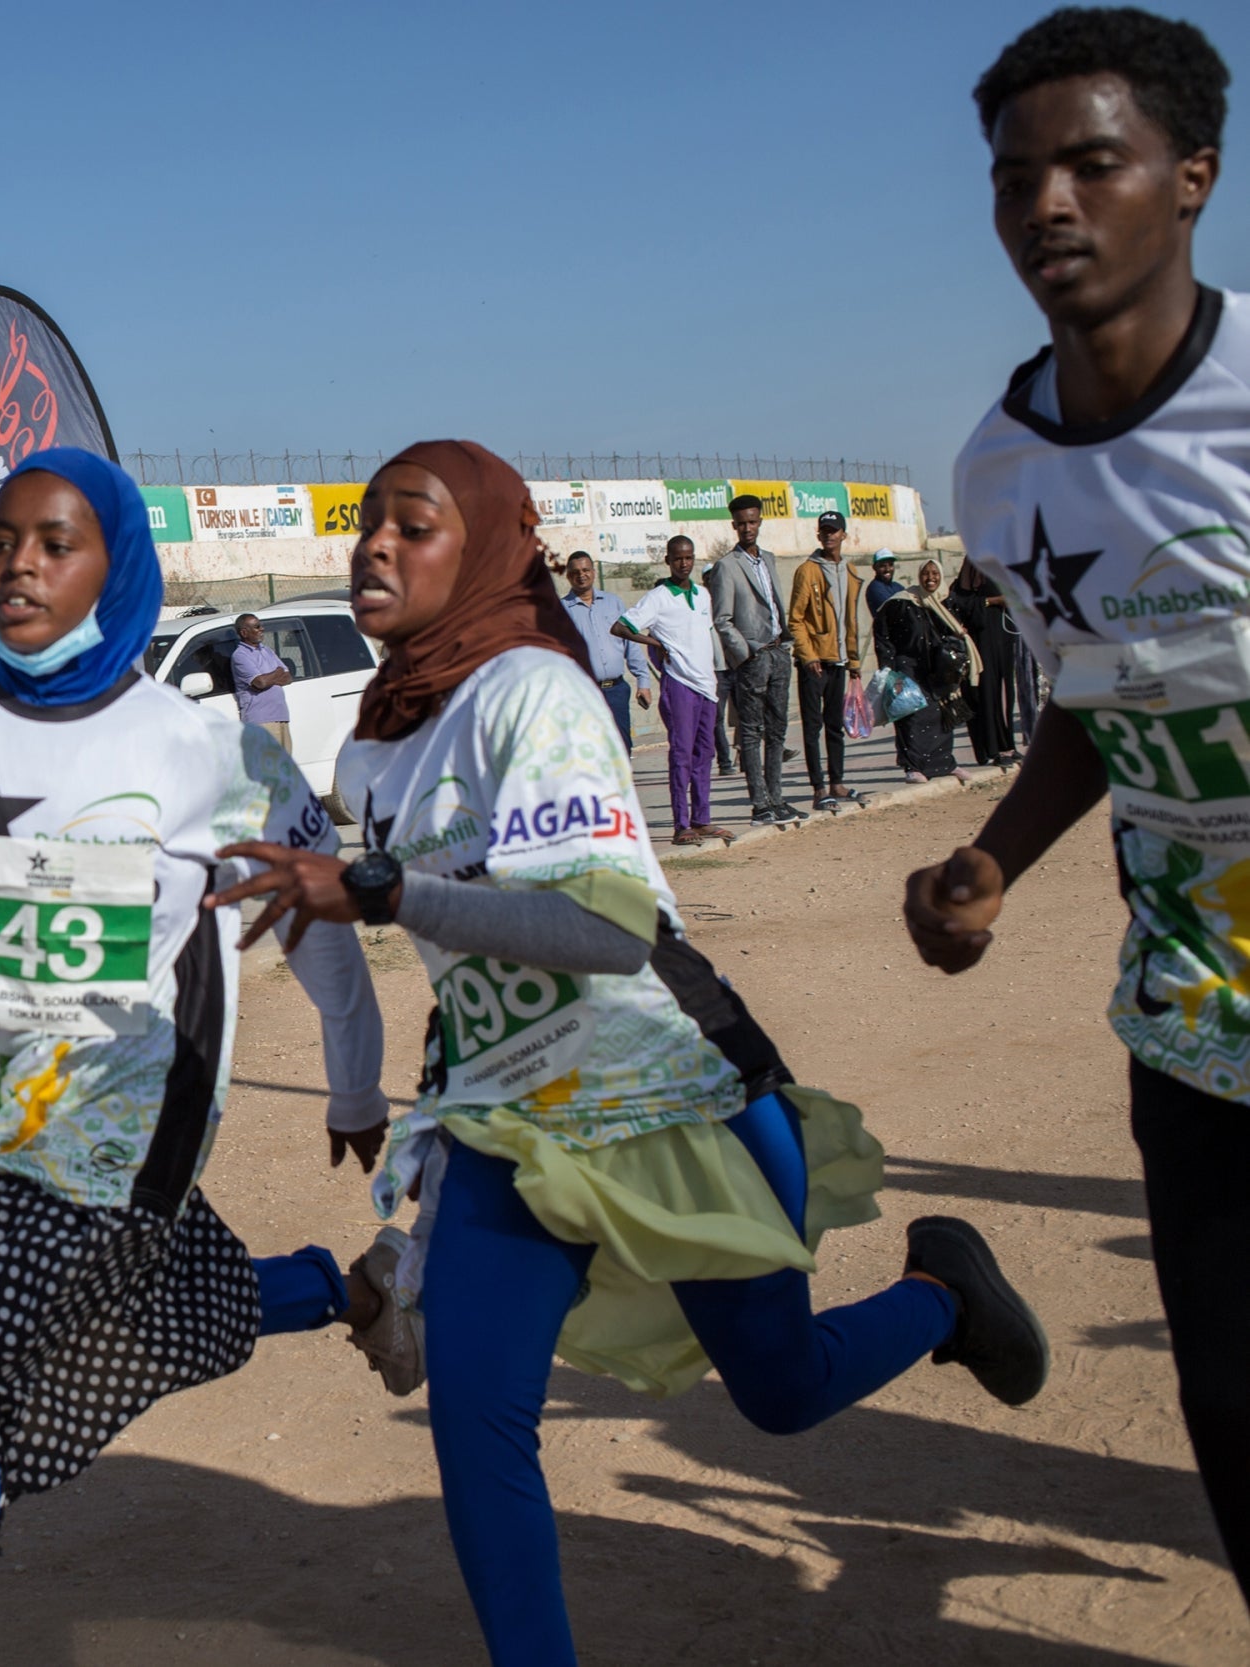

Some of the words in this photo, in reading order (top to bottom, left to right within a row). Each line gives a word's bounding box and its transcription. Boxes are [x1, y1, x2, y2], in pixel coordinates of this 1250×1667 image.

[610, 496, 663, 517] somcable
[669, 485, 728, 511] Dahabshiil
[761, 490, 788, 517] mtel
[855, 492, 889, 517] somtel
[197, 509, 237, 529] TURKISH
[239, 508, 260, 527] NILE
[44, 994, 130, 1007] SOMALILAND
[439, 957, 559, 1060] 298
[8, 1008, 42, 1021] 10KM
[45, 1010, 82, 1023] RACE
